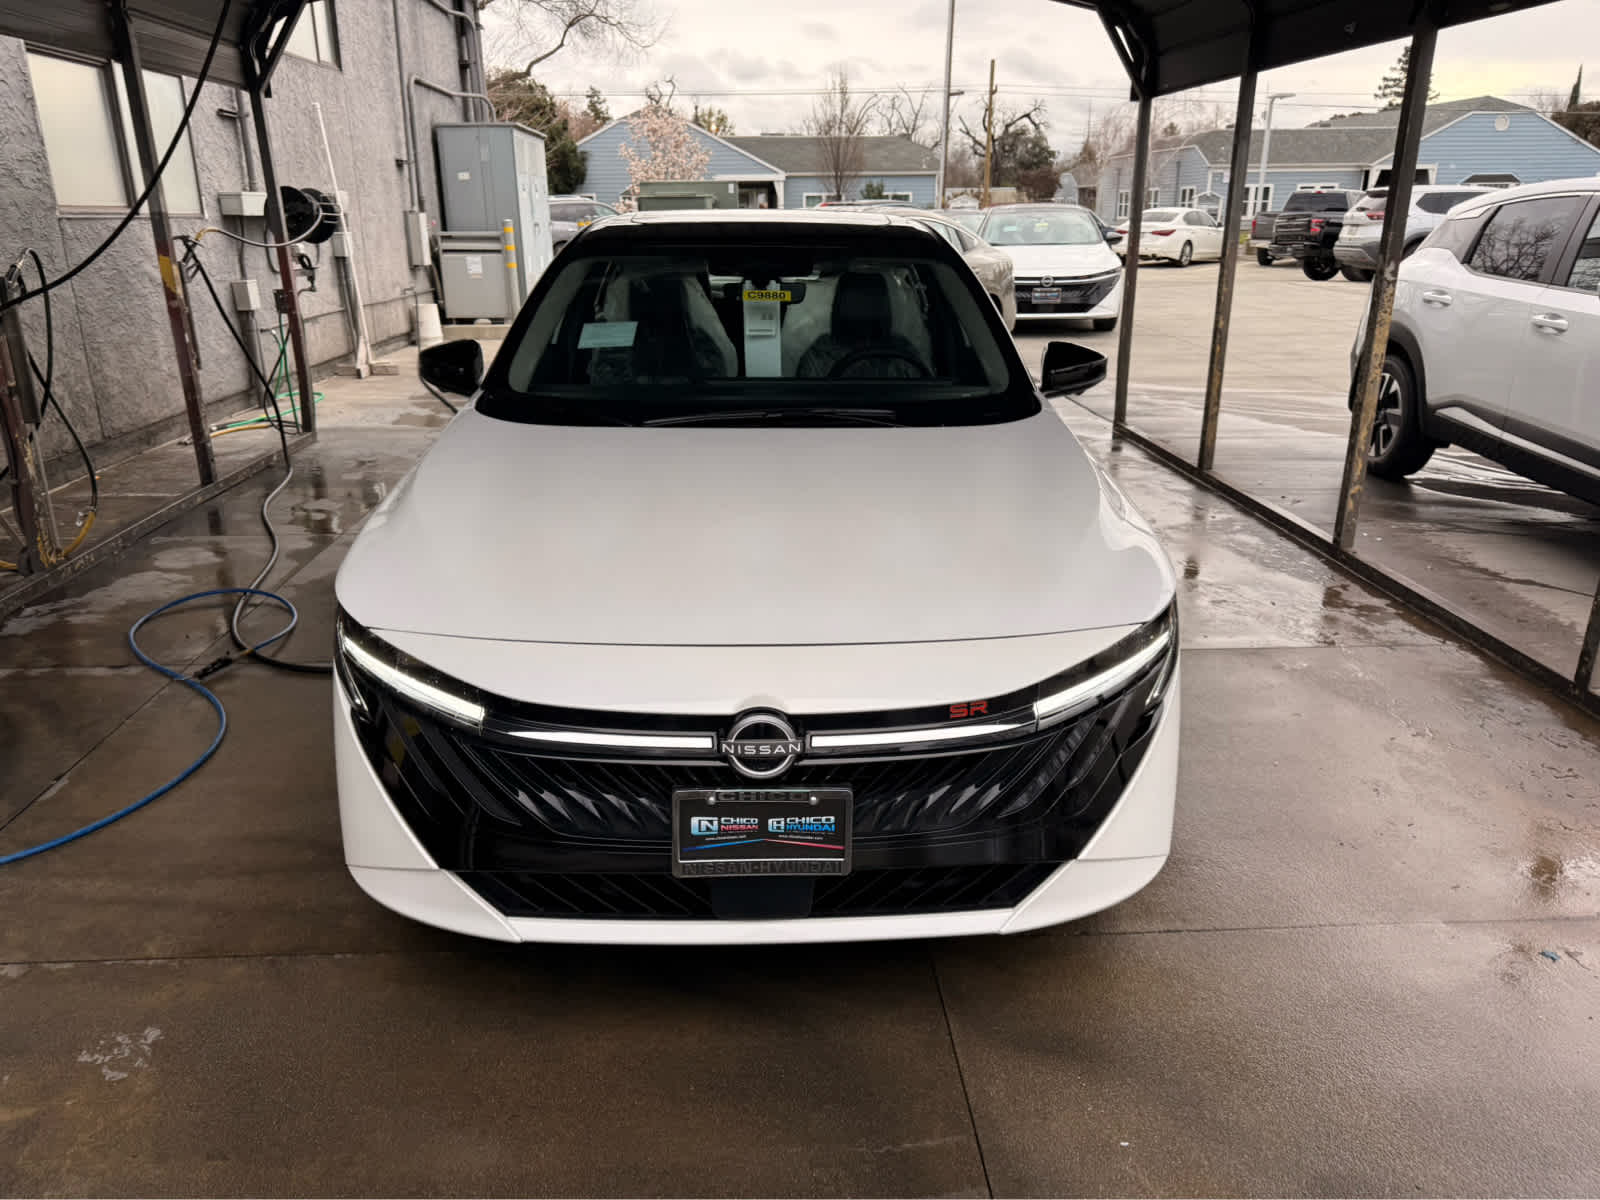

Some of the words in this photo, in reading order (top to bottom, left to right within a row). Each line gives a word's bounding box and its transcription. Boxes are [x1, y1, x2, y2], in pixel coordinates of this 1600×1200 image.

[747, 291, 786, 300] C9880
[949, 700, 988, 718] SR
[721, 742, 801, 755] NISSAN
[716, 791, 809, 801] CHICO
[720, 817, 759, 825] CHICO
[786, 815, 835, 824] CHICO
[786, 824, 836, 832] HYUNDAI
